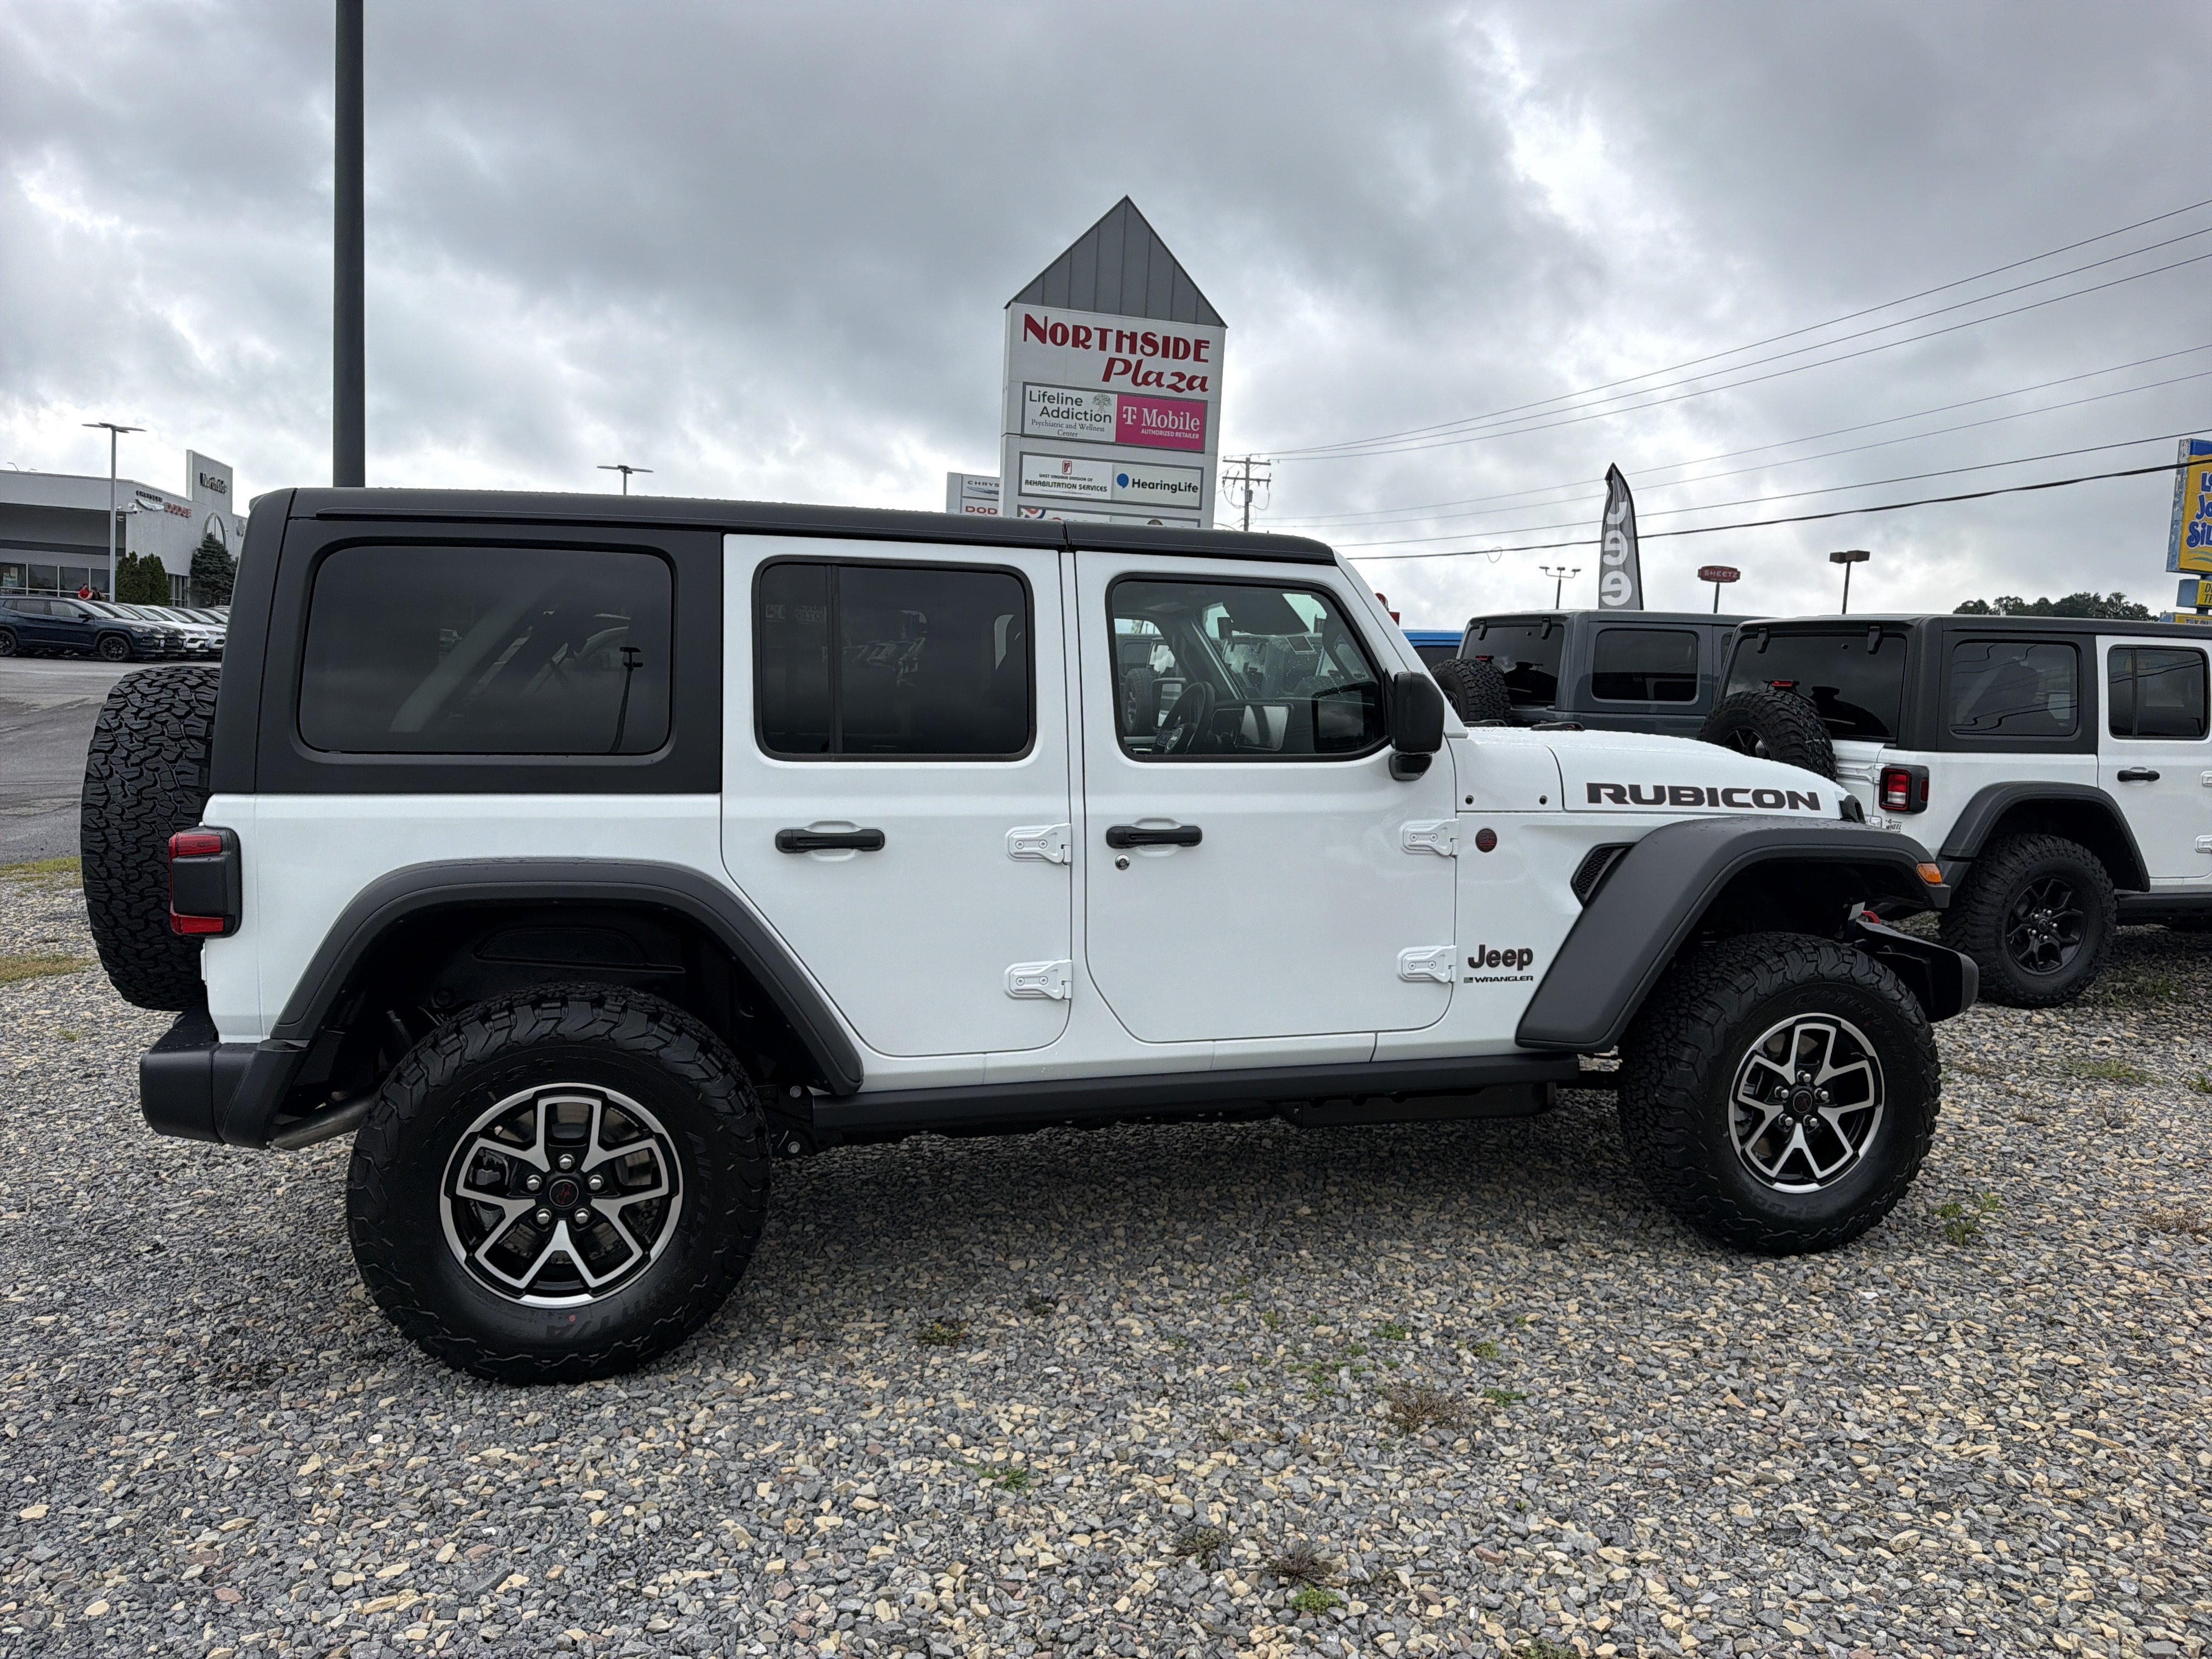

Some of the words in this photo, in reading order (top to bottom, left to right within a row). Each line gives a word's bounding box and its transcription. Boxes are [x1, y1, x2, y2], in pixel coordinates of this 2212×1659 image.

[1024, 313, 1210, 363] NORTHSIDE
[1102, 357, 1209, 393] Plaza
[1029, 390, 1083, 407] Lifeline
[1040, 406, 1112, 424] Addiction
[1141, 408, 1200, 431] Mobile
[1031, 419, 1064, 428] Psychiatric
[1079, 423, 1105, 432] Wellness
[1057, 429, 1078, 437] Center
[1141, 428, 1174, 437] AUTHORIZED
[1025, 479, 1077, 489] REHABILITATION
[1079, 484, 1108, 492] SERVICES
[1132, 478, 1199, 493] HearingLife
[1705, 569, 1737, 578] SHEETZ
[1586, 782, 1821, 811] RUBICON
[1468, 944, 1533, 971] Jeep
